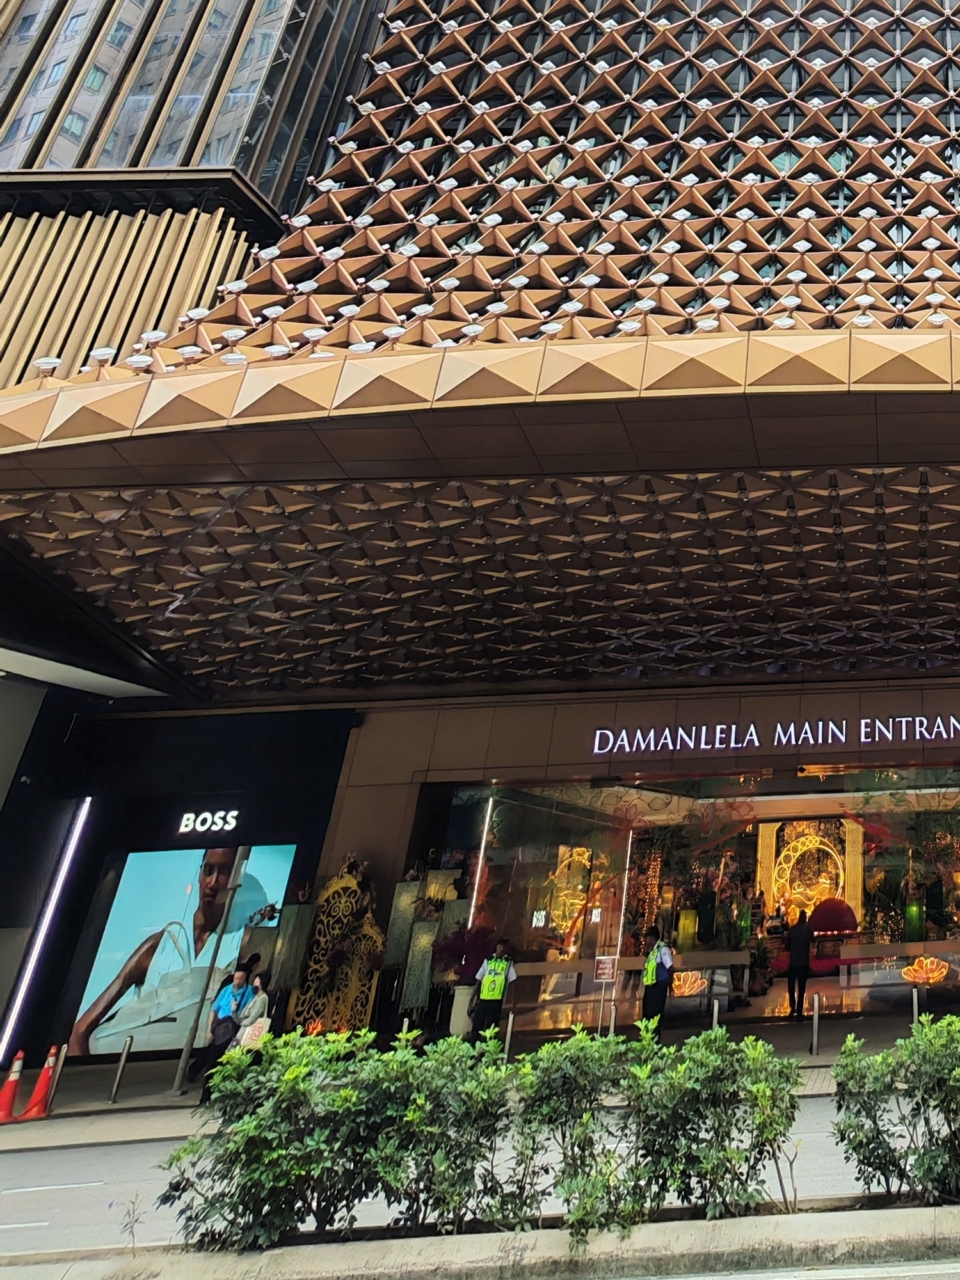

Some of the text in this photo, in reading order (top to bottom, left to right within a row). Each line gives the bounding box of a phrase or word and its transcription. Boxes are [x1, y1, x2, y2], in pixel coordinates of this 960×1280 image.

[593, 723, 760, 754] DAMANLELA
[773, 719, 848, 746] MAIN
[178, 810, 240, 833] BOSS
